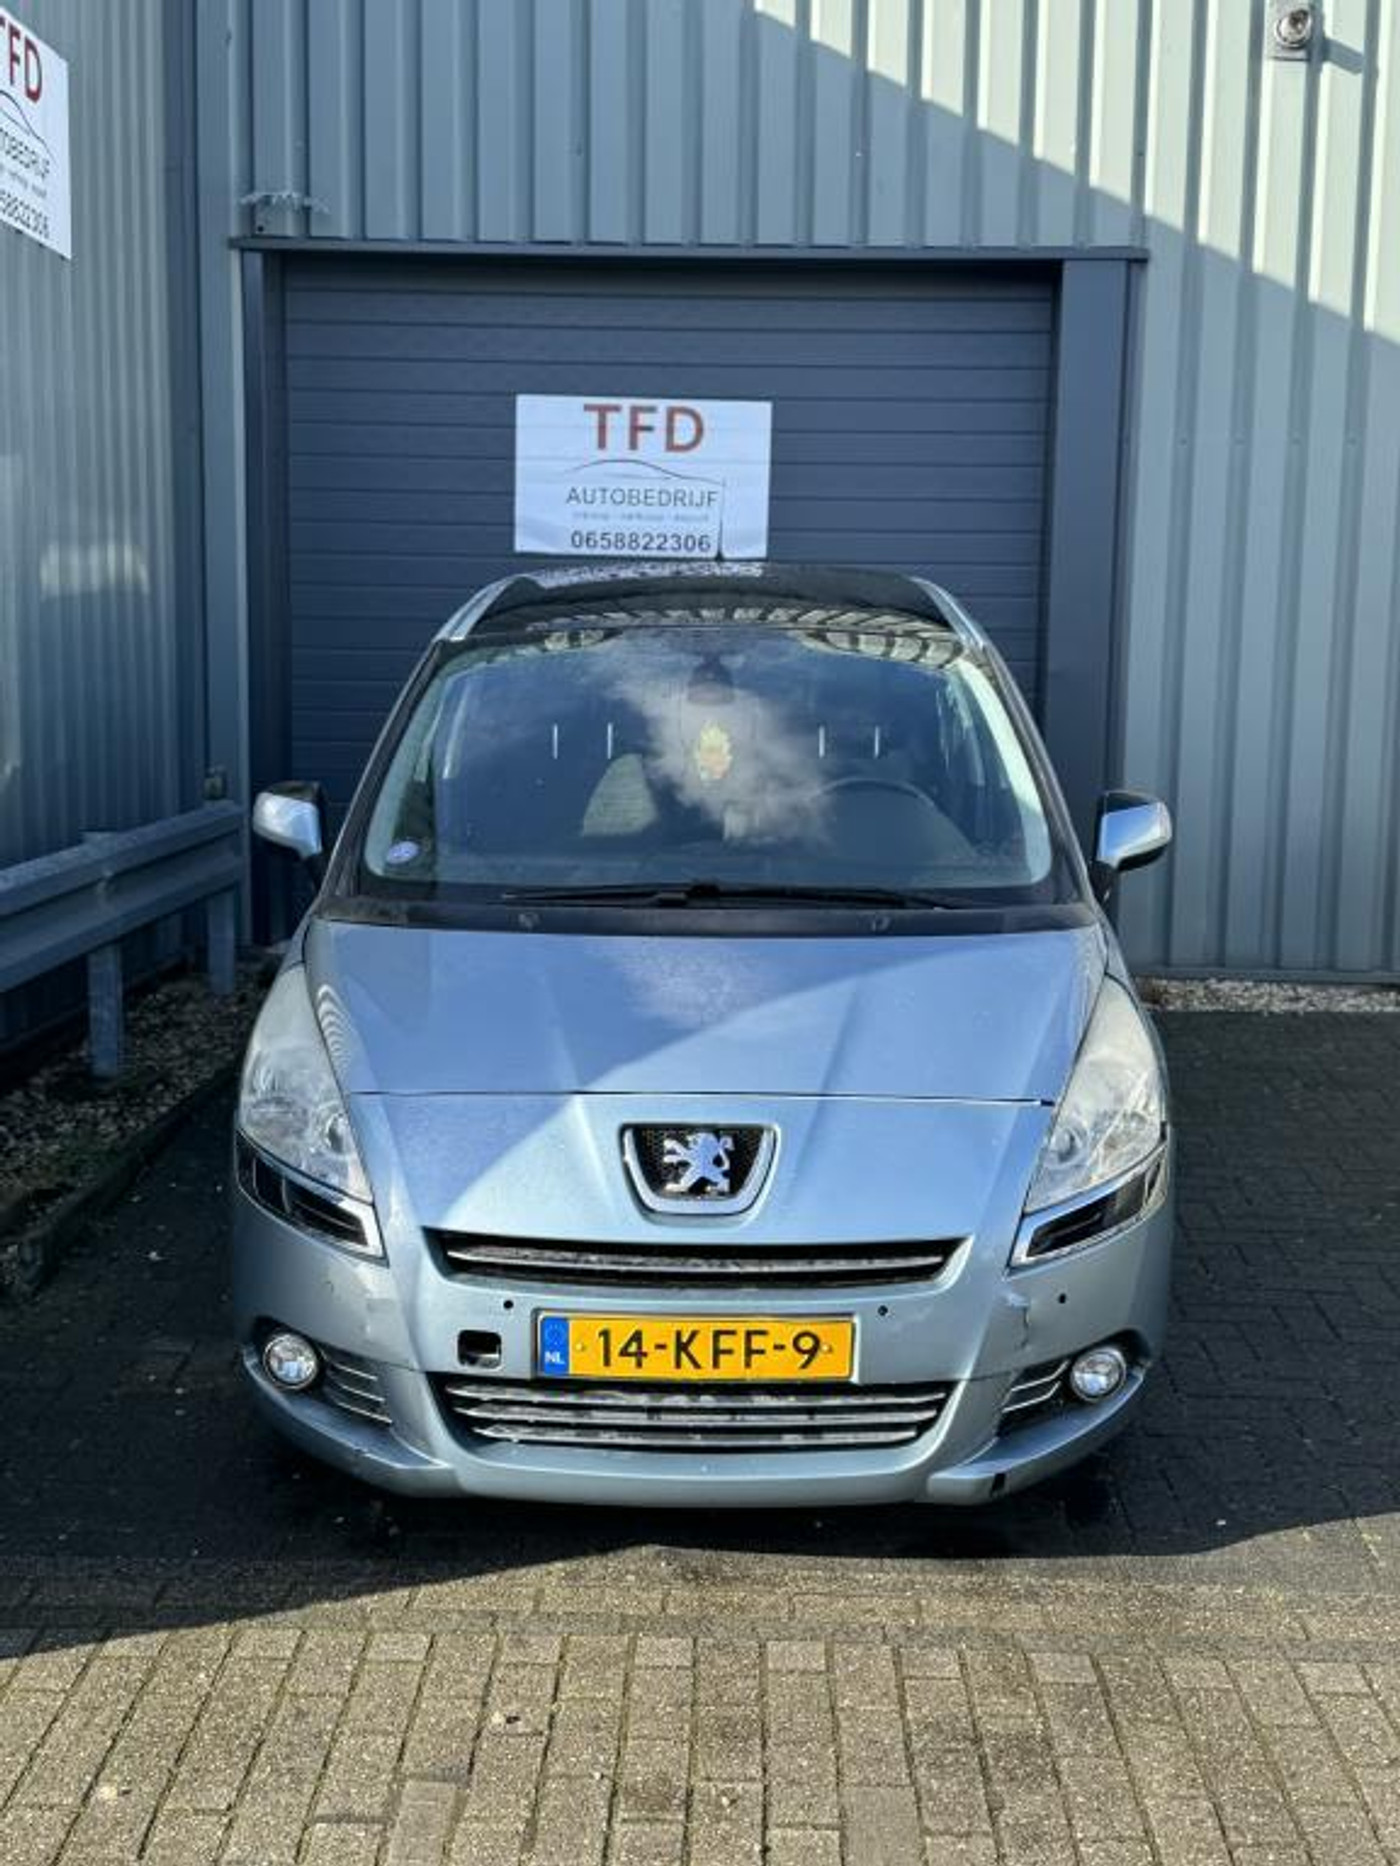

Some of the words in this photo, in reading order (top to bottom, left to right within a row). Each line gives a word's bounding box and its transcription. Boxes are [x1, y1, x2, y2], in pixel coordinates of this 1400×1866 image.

[583, 403, 705, 453] TFD
[565, 486, 719, 508] AUTOBEDRIJF
[570, 530, 712, 552] 0658822306
[544, 1351, 566, 1365] NL
[597, 1328, 822, 1370] 14-KFF-9
